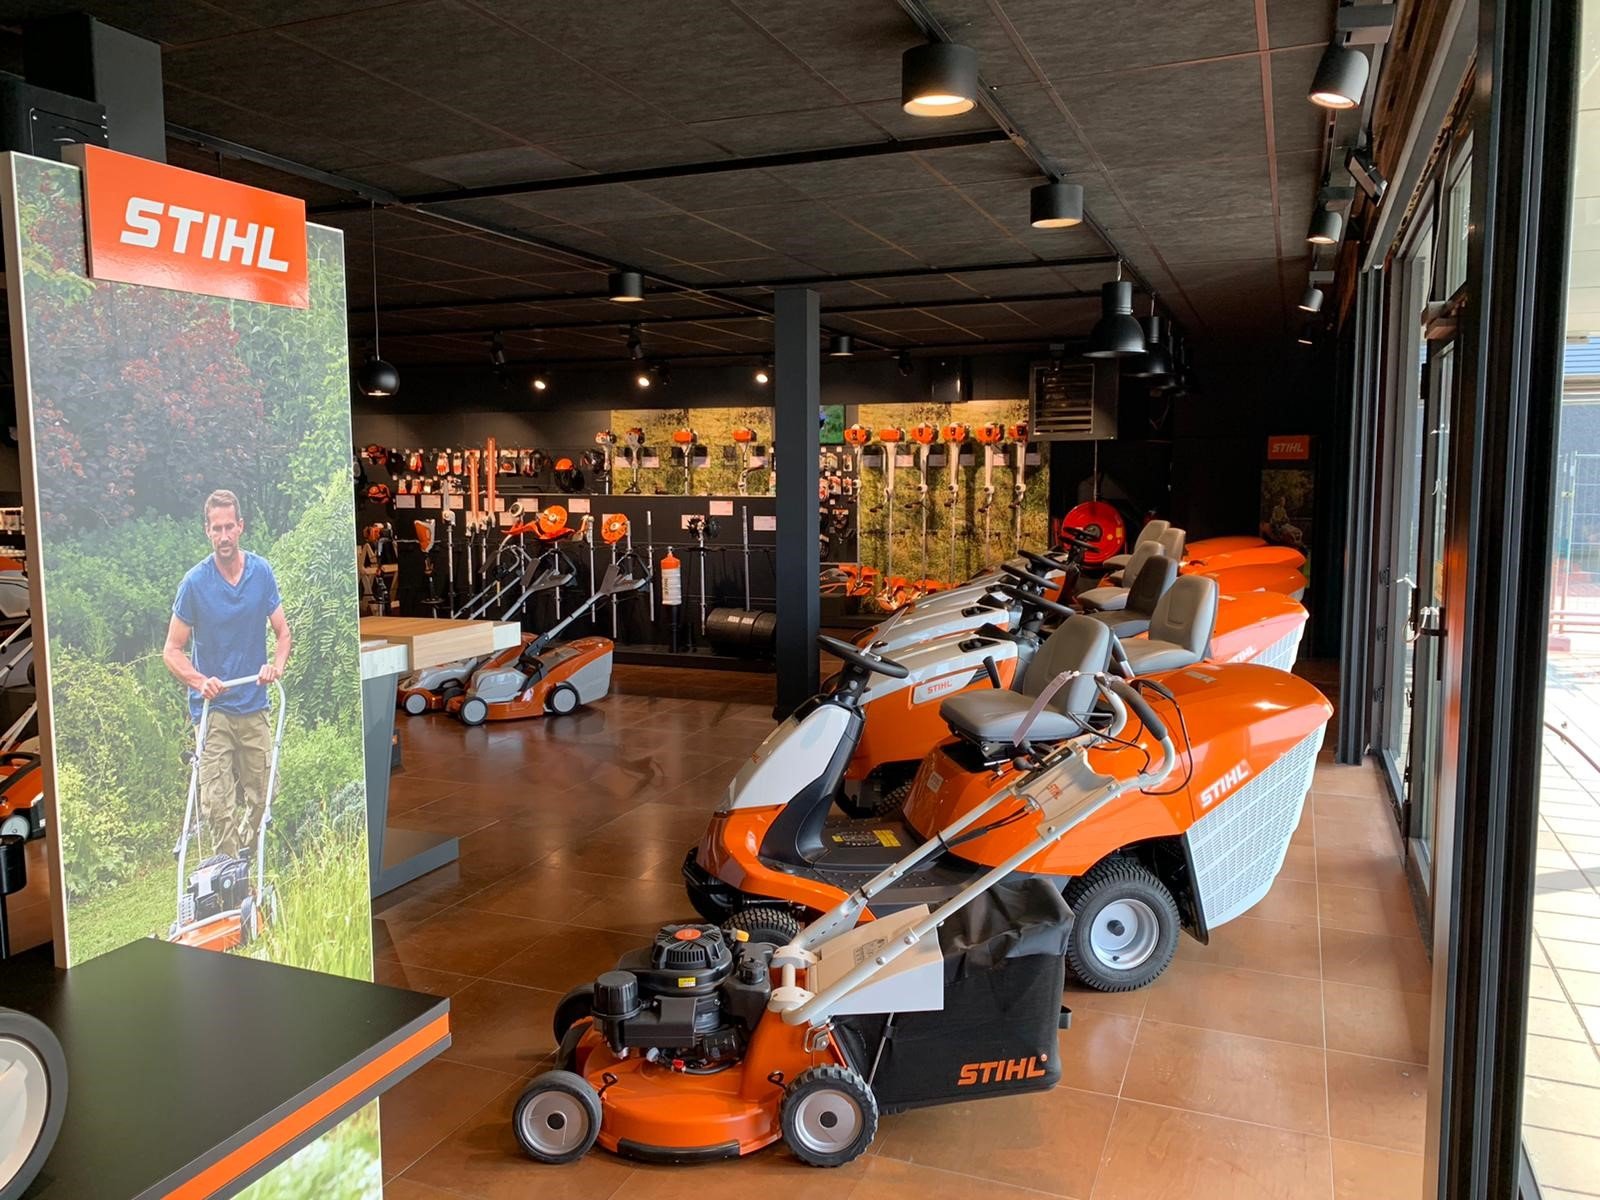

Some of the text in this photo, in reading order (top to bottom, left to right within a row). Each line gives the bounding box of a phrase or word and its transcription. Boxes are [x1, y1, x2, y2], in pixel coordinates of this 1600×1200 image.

[119, 196, 289, 273] STIHL
[1271, 442, 1304, 453] STIHL
[927, 680, 952, 694] STIHL
[1200, 764, 1249, 808] STIHL
[957, 1056, 1046, 1086] STIHL
